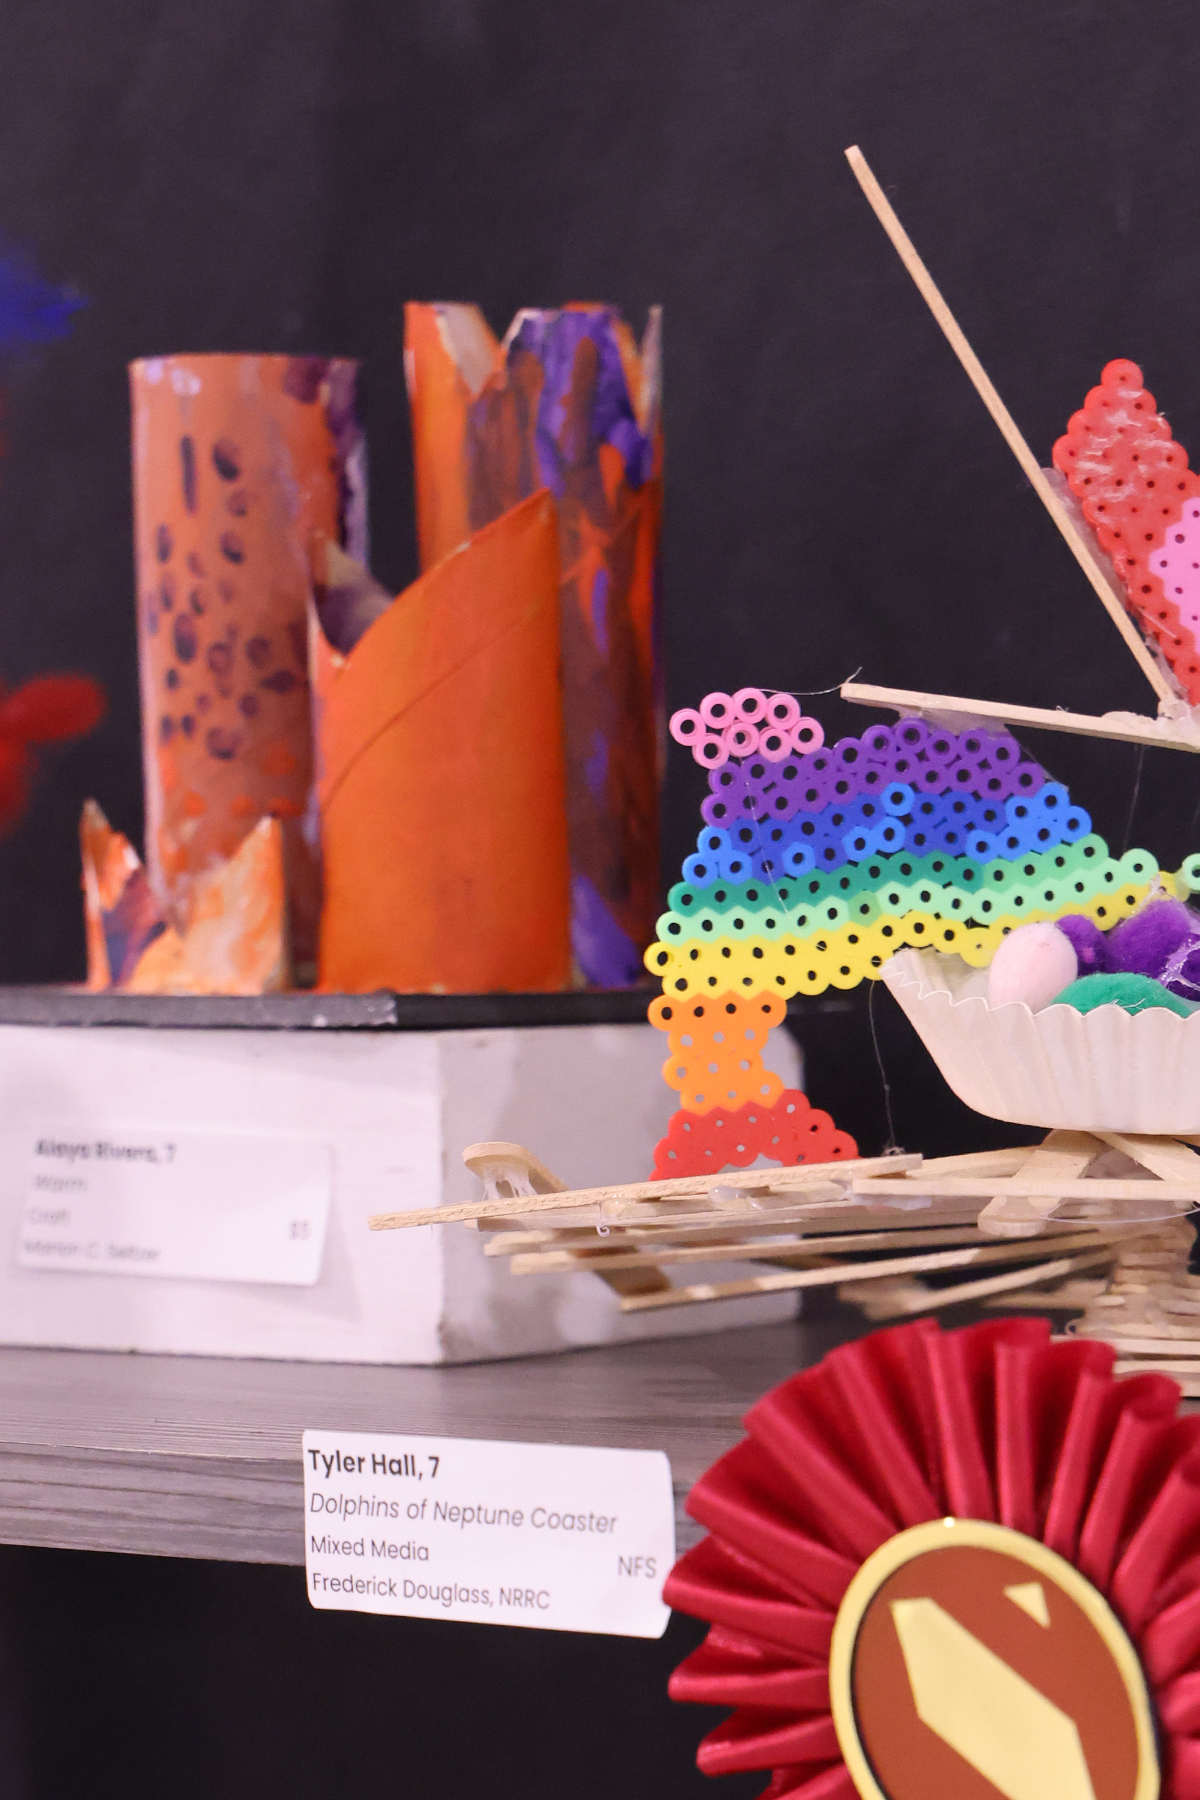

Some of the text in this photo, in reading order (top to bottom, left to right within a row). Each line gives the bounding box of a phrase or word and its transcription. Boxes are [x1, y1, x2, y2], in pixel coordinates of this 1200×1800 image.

[308, 1449, 440, 1481] Tyler Hall, 7
[310, 1492, 618, 1533] Dolphins of Neptune Coaster
[311, 1535, 429, 1561] Mixed Media
[617, 1555, 657, 1579] NFS
[313, 1573, 550, 1610] Frederick Douglass, NRRC
